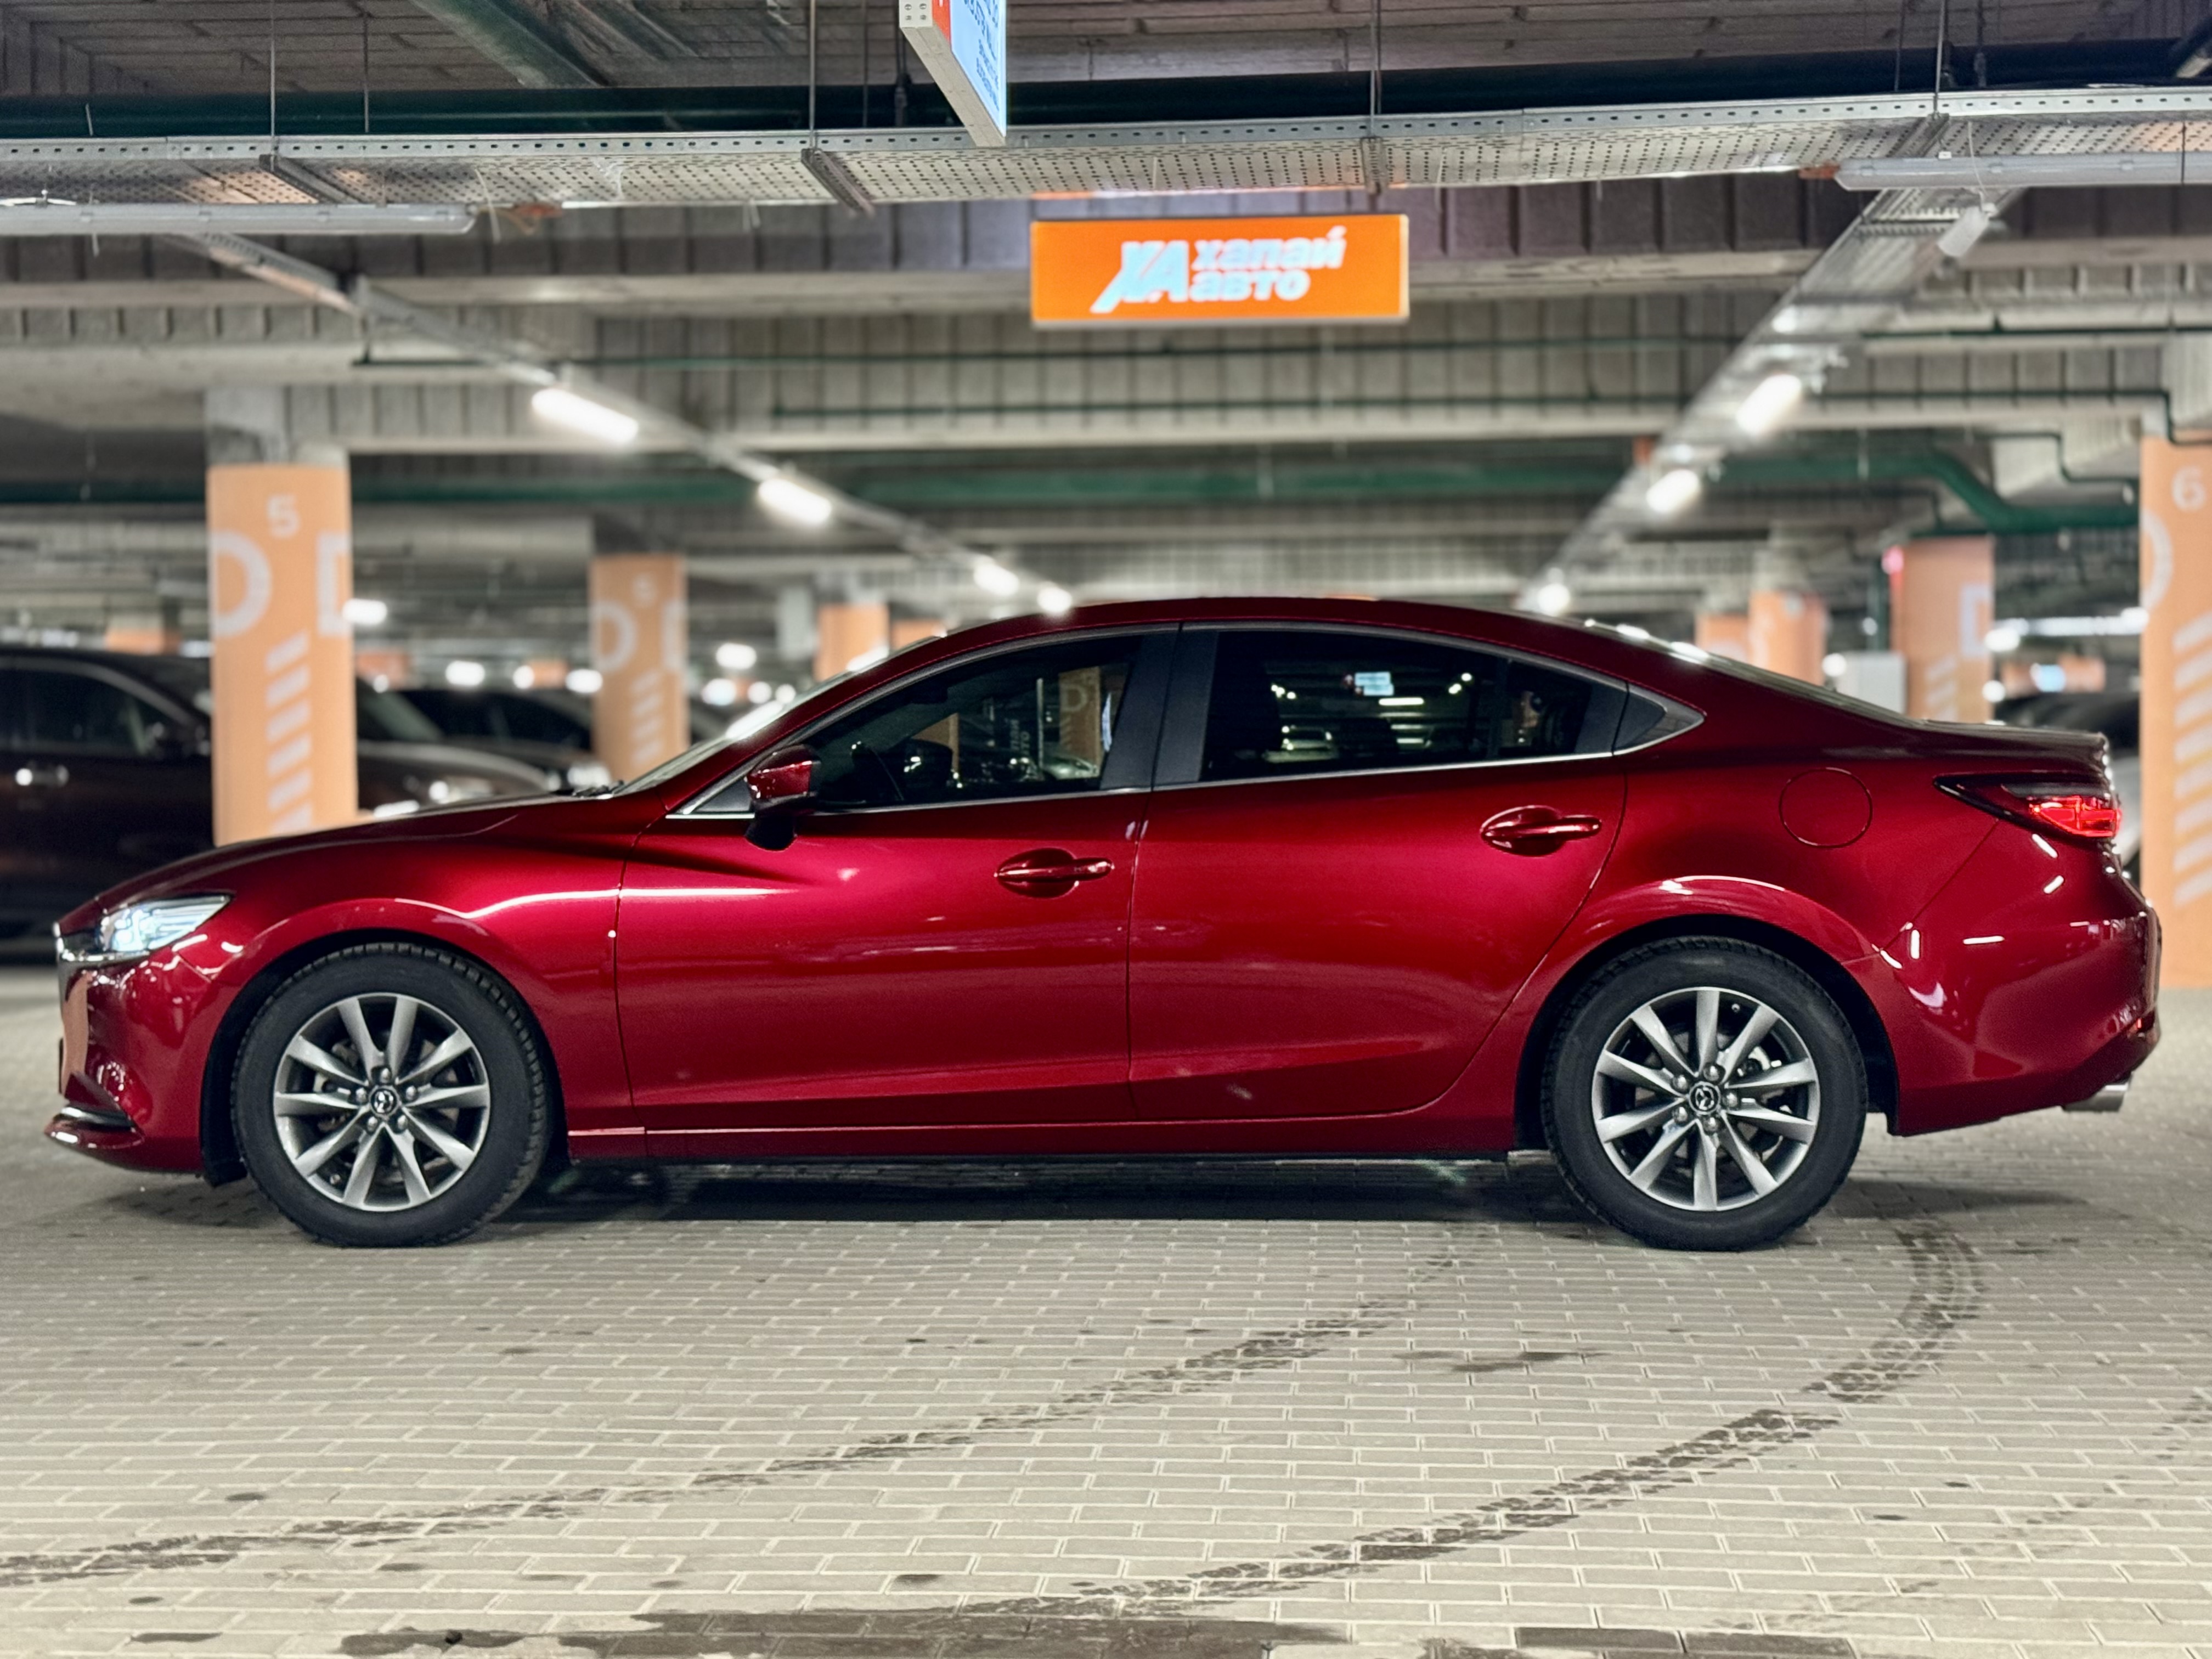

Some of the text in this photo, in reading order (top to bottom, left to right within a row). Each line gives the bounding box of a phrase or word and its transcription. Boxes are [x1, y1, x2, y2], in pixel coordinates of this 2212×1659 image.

[1191, 225, 1346, 269] хапай
[1189, 269, 1311, 301] авто
[2171, 466, 2206, 512] 6
[266, 493, 300, 538] 5
